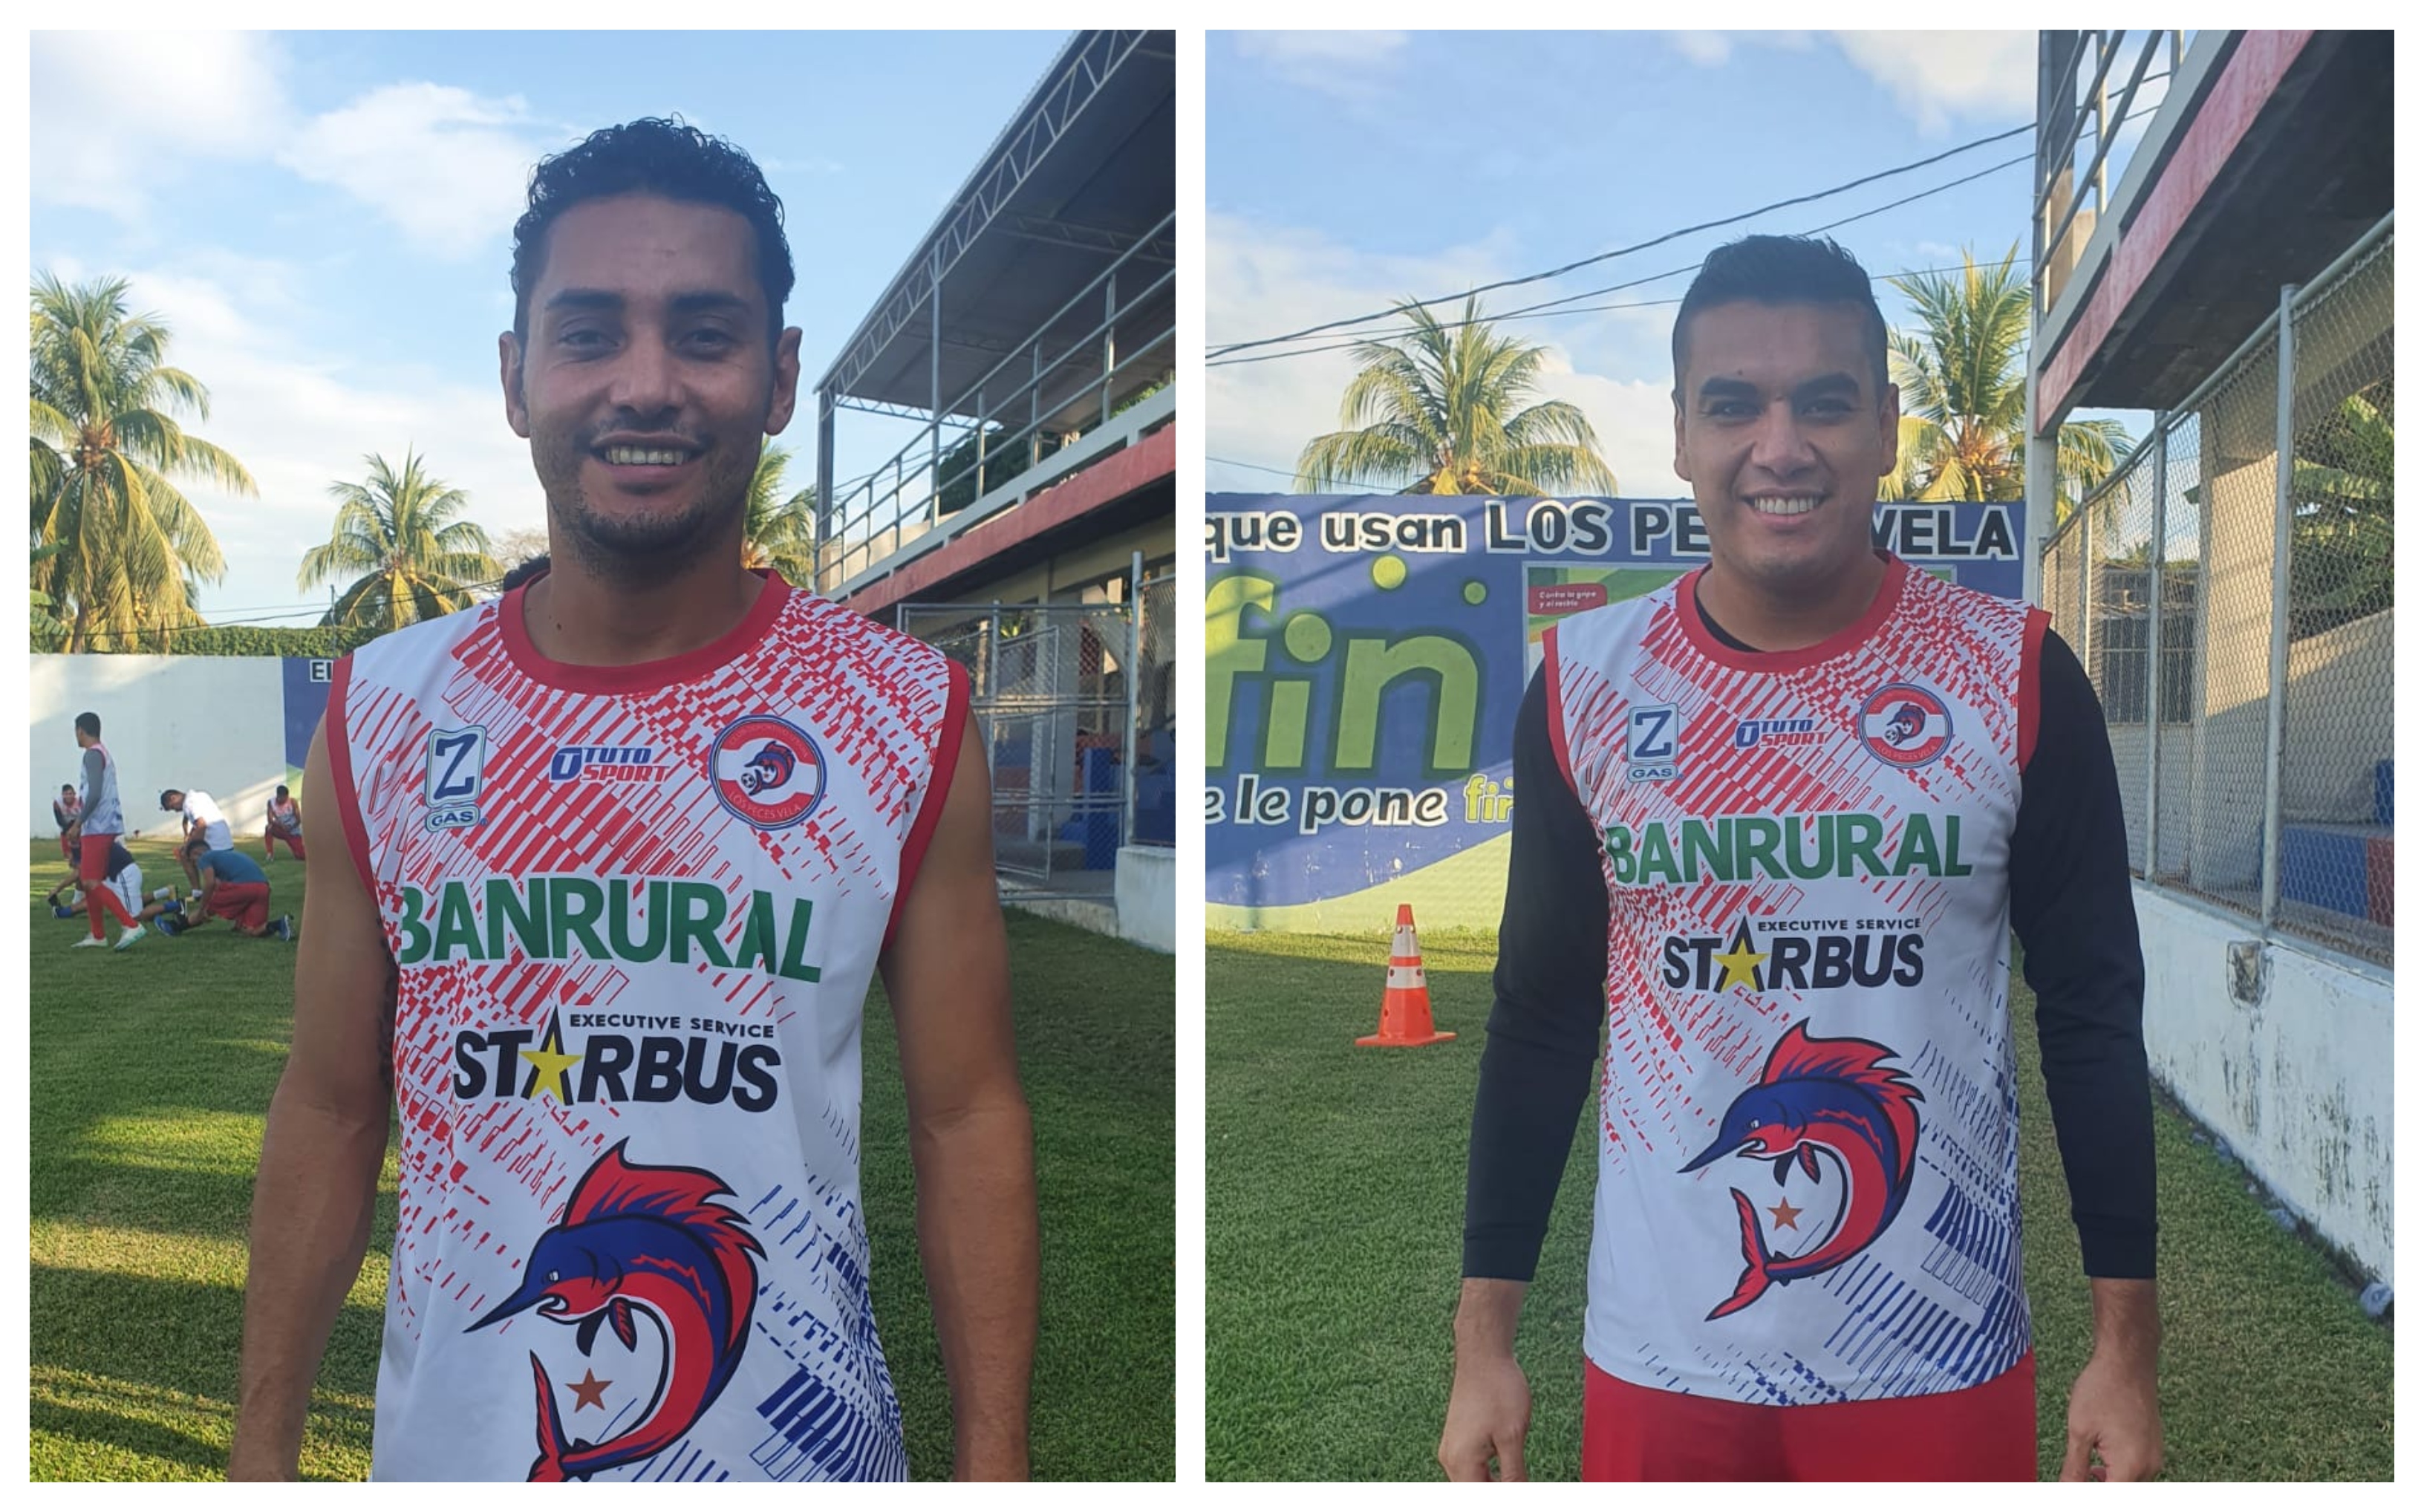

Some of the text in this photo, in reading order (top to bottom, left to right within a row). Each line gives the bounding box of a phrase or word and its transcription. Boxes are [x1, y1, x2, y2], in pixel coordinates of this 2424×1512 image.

[1321, 512, 1466, 552] usan
[1488, 502, 1611, 553] LOS
[1634, 710, 1672, 757] Z
[1759, 719, 1814, 732] TUTO
[1760, 732, 1827, 746] SPORT
[434, 734, 478, 800] Z
[583, 747, 652, 764] TUTO
[1632, 768, 1672, 778] GAS
[581, 765, 669, 783] SPORT
[431, 810, 475, 827] GAS
[1236, 775, 1290, 824] le
[1300, 787, 1447, 833] pone
[1606, 813, 1973, 884] BANRURAL
[401, 878, 821, 983] BANRURAL
[1757, 917, 1921, 932] EXECUTIVE SERVICE
[1663, 915, 1925, 994] STARBUS
[569, 1013, 775, 1039] EXECUTIVE SERVICE
[453, 1003, 781, 1113] STARBUS
